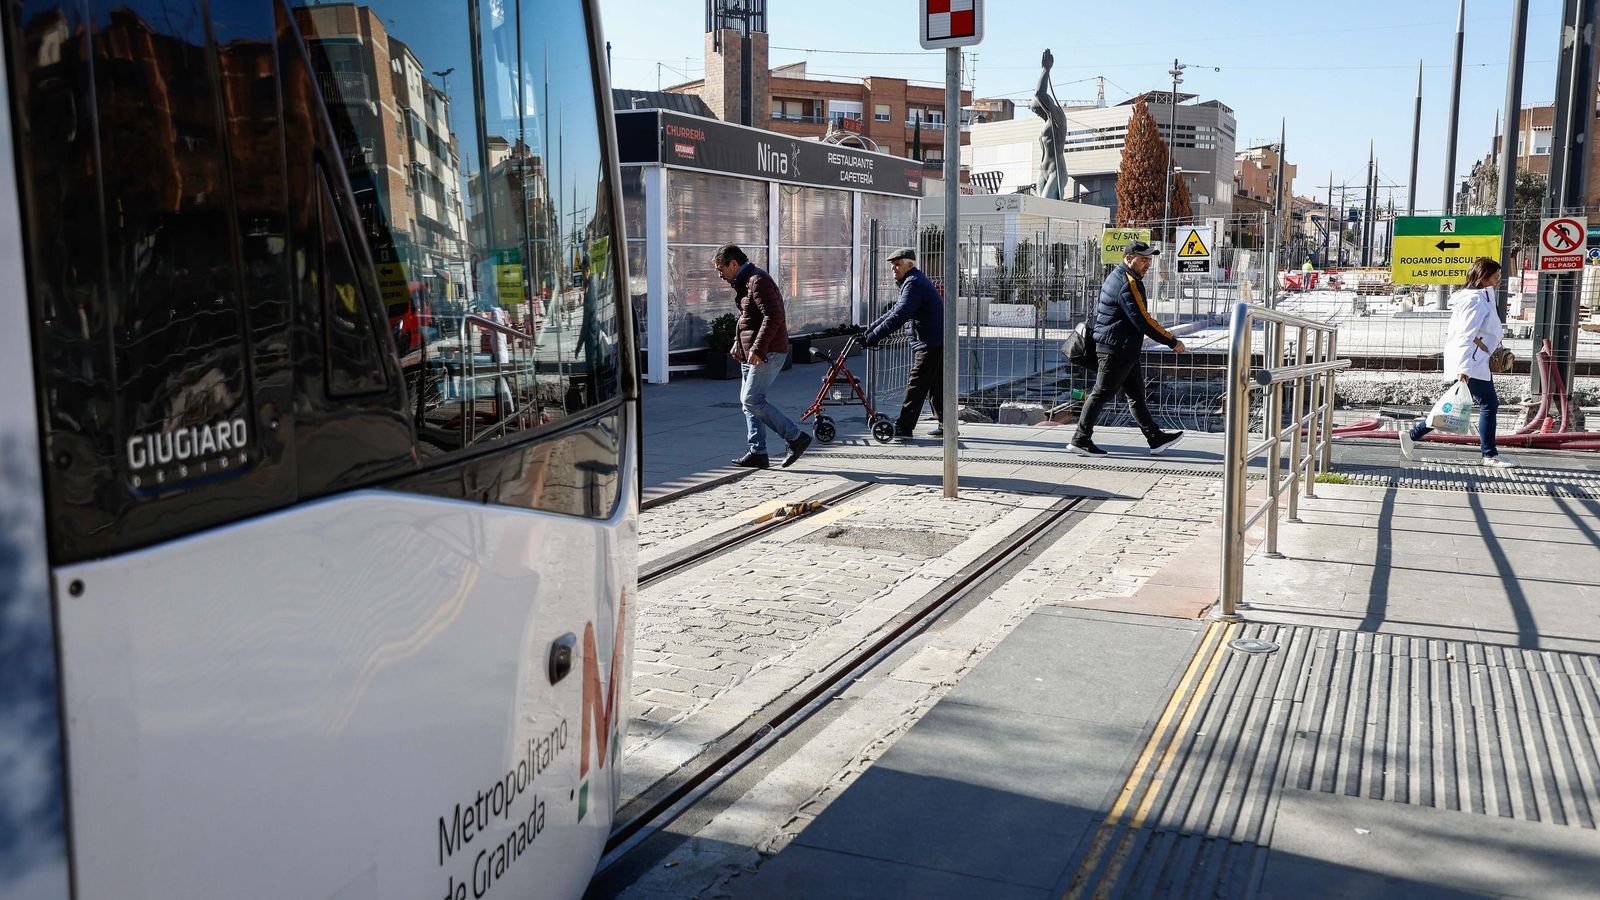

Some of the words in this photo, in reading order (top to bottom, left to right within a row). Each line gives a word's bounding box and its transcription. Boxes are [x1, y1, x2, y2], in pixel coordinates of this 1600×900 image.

[666, 123, 705, 142] CHURRERÍA
[757, 141, 788, 175] Nina
[827, 152, 874, 170] RESTAURANTE
[840, 170, 874, 186] CAFETERÍA
[1113, 232, 1122, 241] C/
[1123, 232, 1139, 240] SAN
[1105, 244, 1125, 252] CAYE
[1400, 256, 1443, 264] ROGAMOS
[1412, 269, 1428, 277] LAS
[1430, 269, 1467, 277] MOLESTI
[127, 418, 248, 470] GIUGIARO
[131, 451, 249, 488] DESIGN
[439, 718, 568, 867] Metropolitano
[473, 794, 546, 900] Granada
